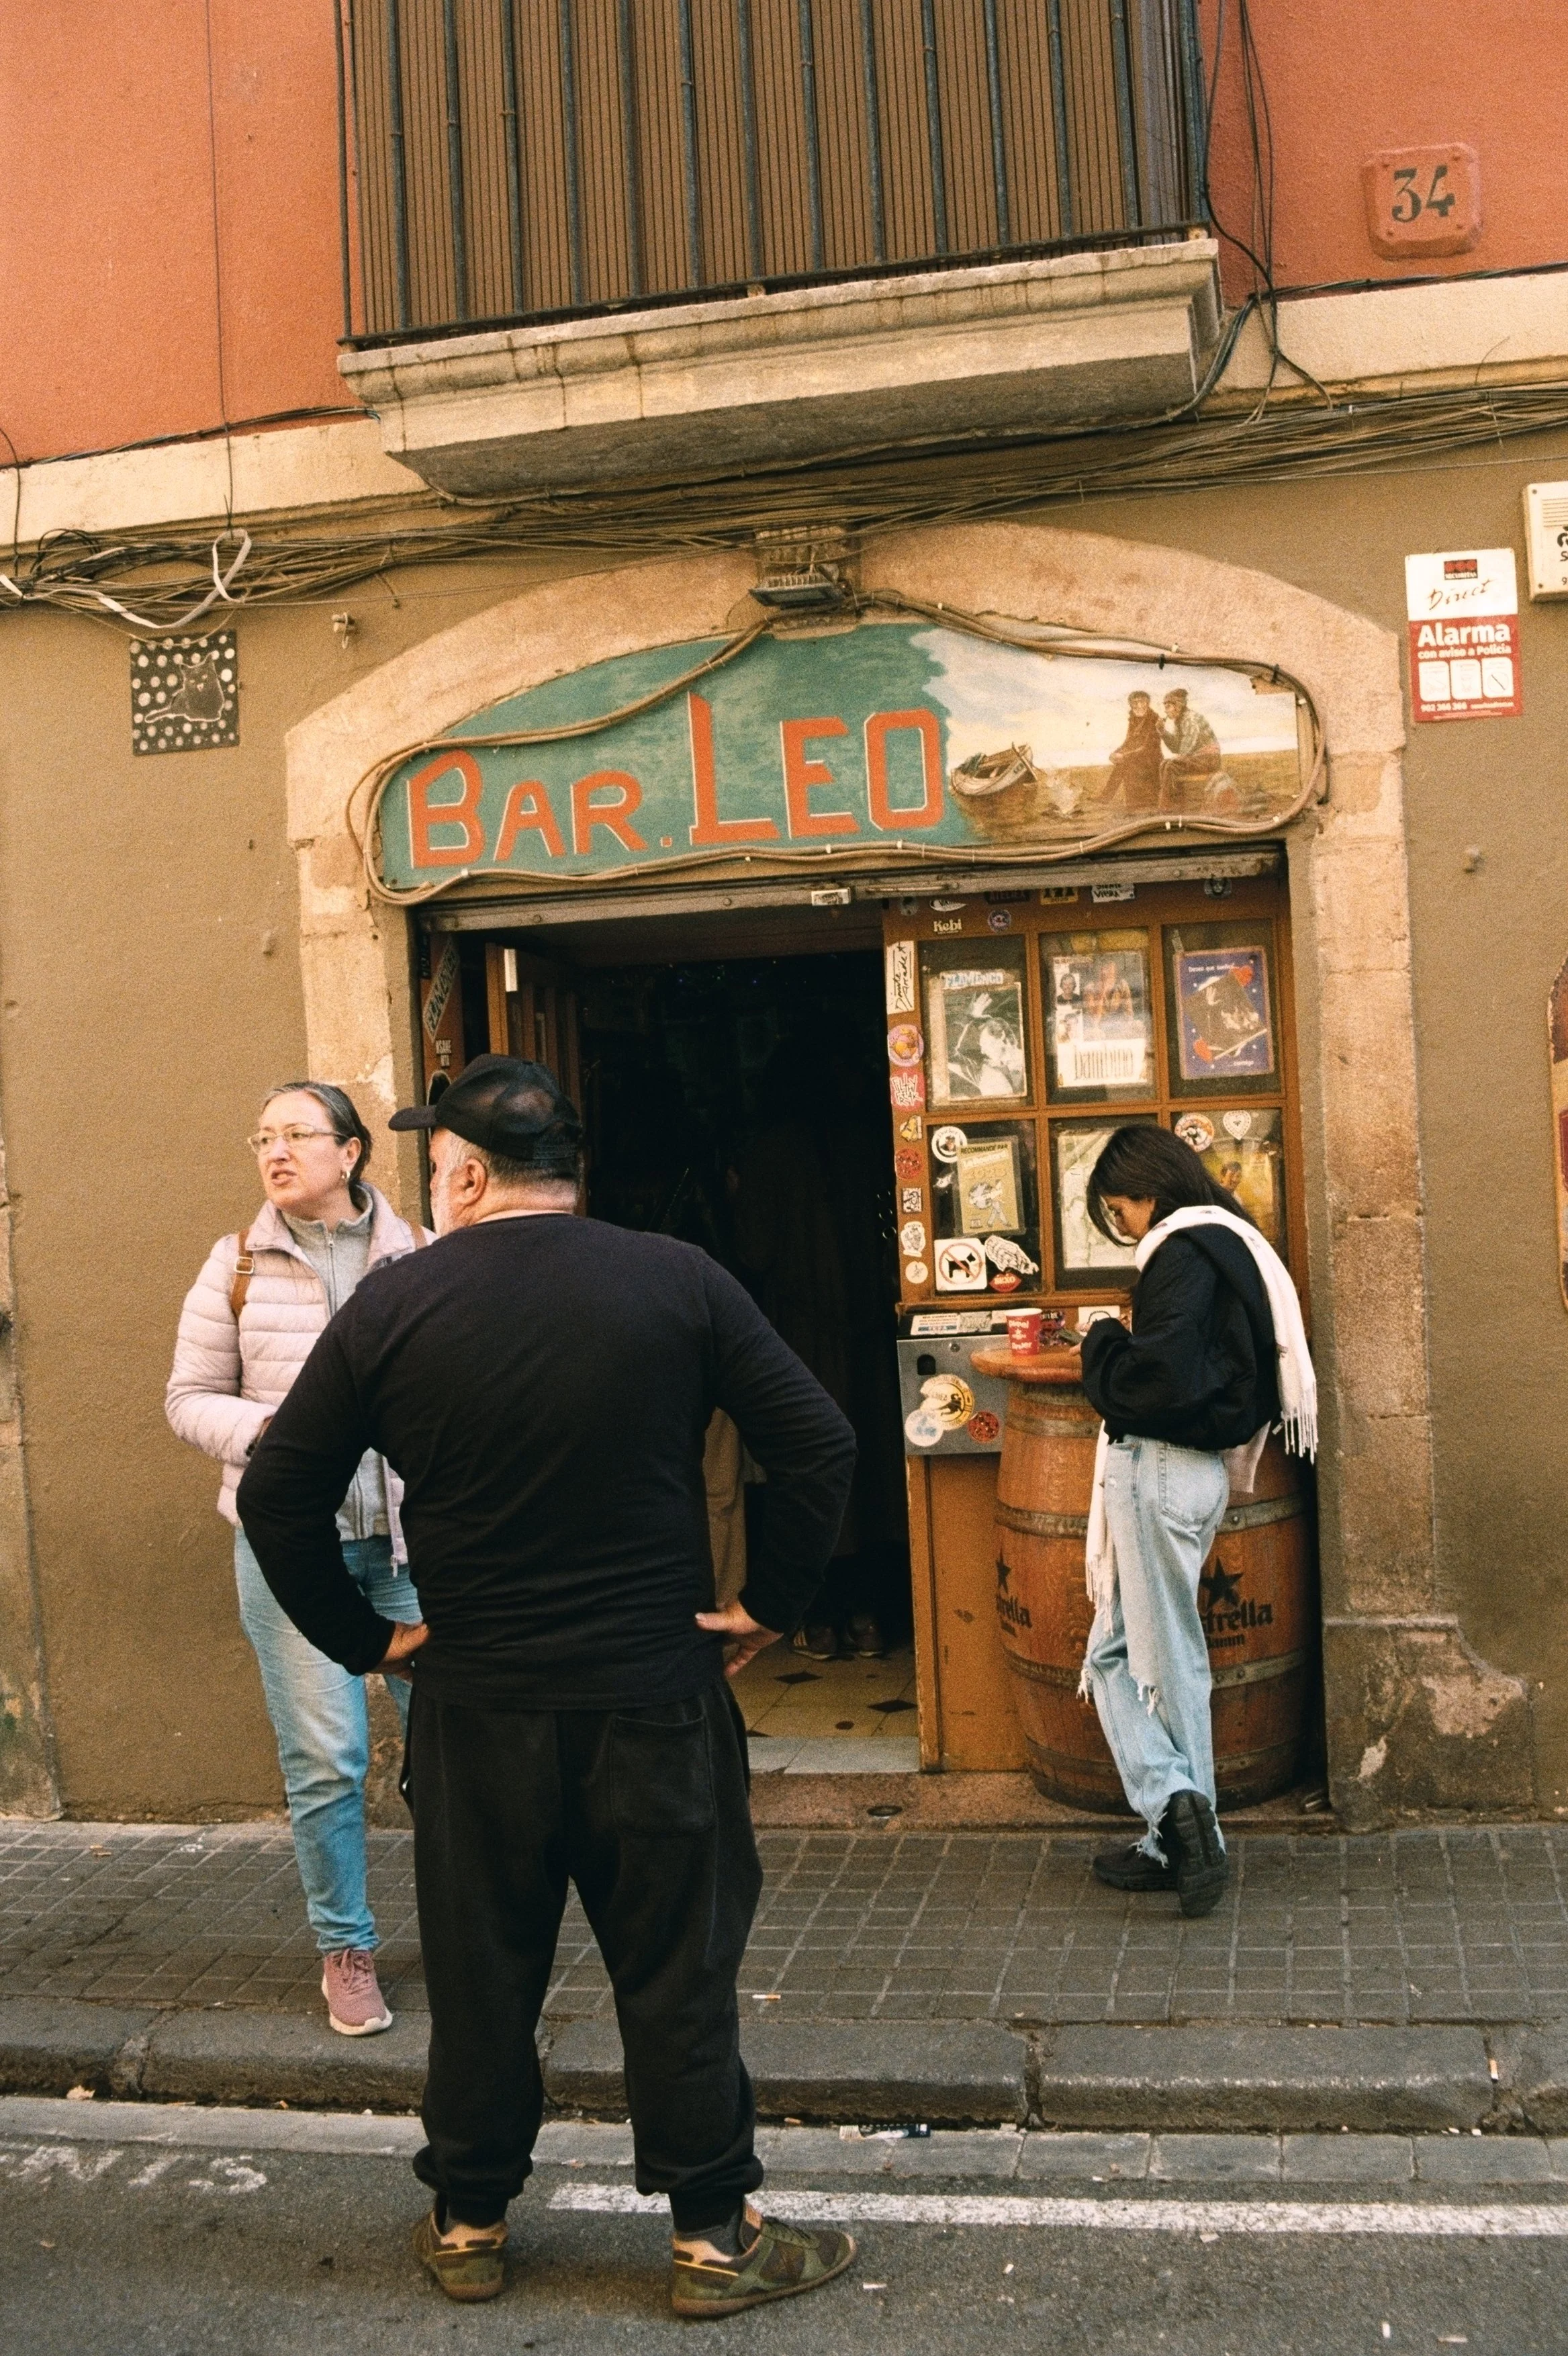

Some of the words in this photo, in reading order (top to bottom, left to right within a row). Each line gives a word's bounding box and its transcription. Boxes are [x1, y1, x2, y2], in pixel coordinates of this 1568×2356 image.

[1391, 165, 1455, 223] 34
[1427, 579, 1497, 610] Direct
[1418, 622, 1511, 648] Alarma
[1418, 649, 1437, 660] con
[1438, 647, 1467, 658] aviso
[1467, 647, 1475, 656] a
[688, 690, 944, 846] LEO
